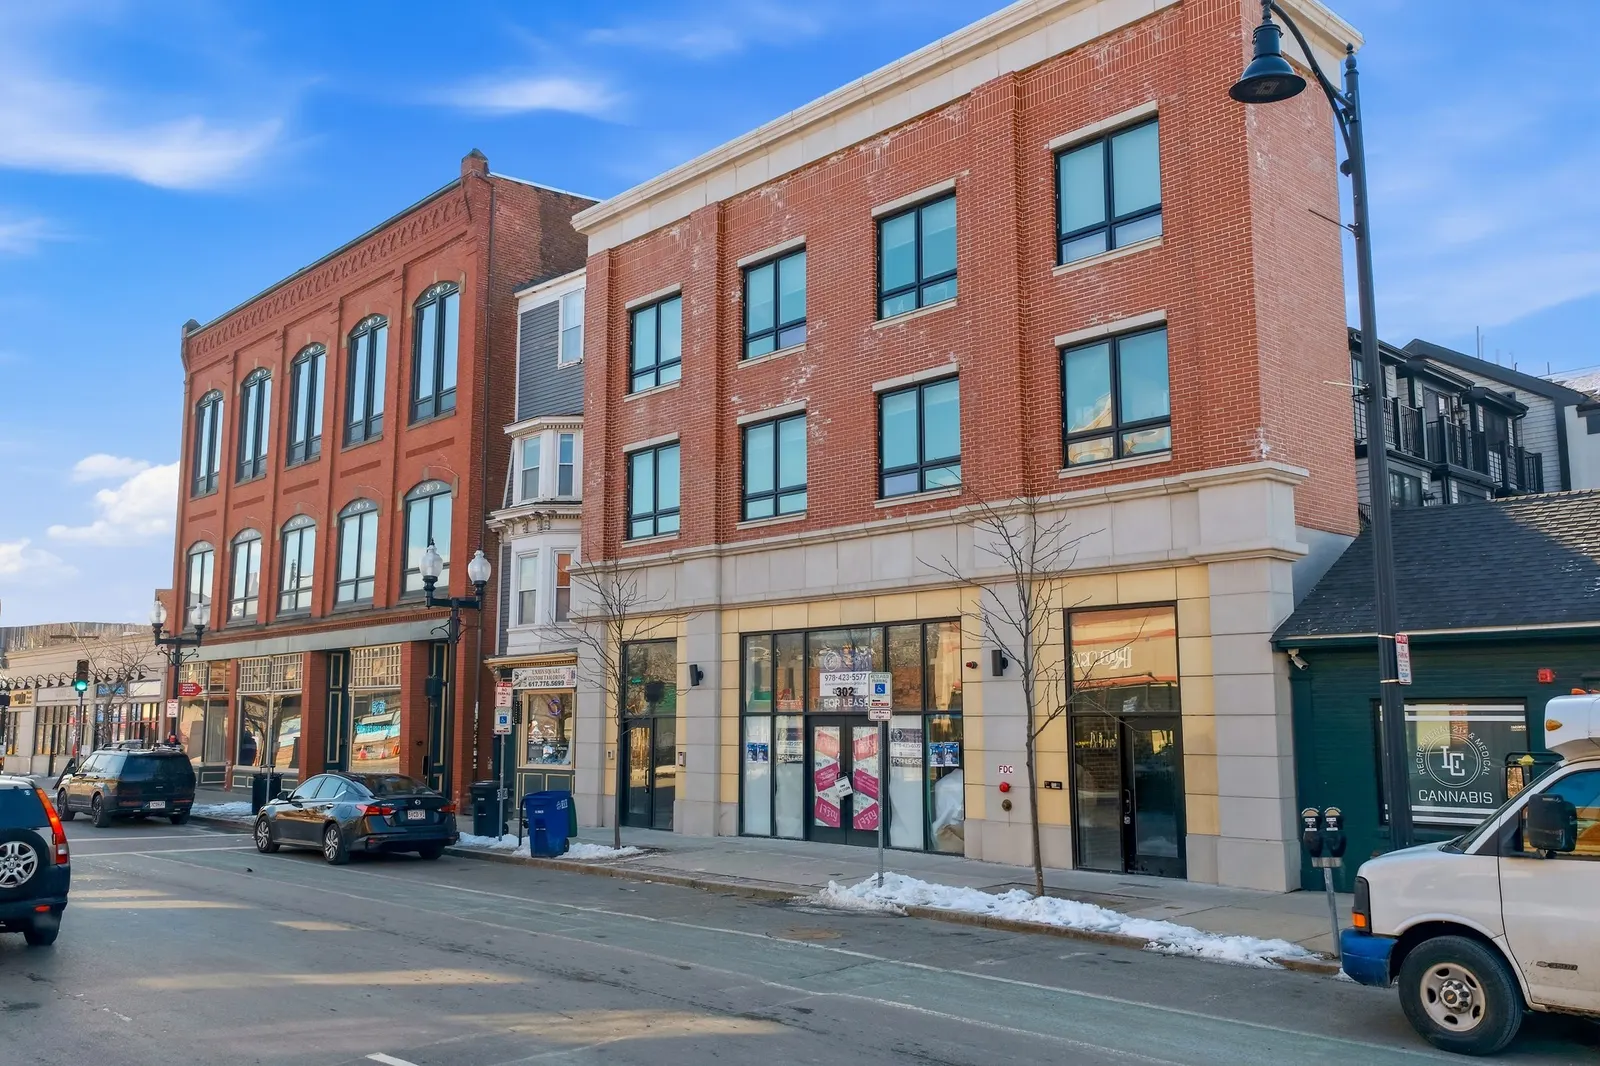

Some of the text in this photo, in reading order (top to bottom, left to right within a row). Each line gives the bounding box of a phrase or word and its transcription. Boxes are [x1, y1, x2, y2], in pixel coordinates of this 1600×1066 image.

[824, 673, 867, 682] 978-423-5577
[836, 686, 854, 696] 302
[824, 698, 841, 708] FOR
[1416, 726, 1450, 776] RECREATIONAL
[1474, 738, 1491, 776] MEDICAL
[998, 766, 1012, 774] FDC
[1418, 790, 1493, 804] CANNABIS
